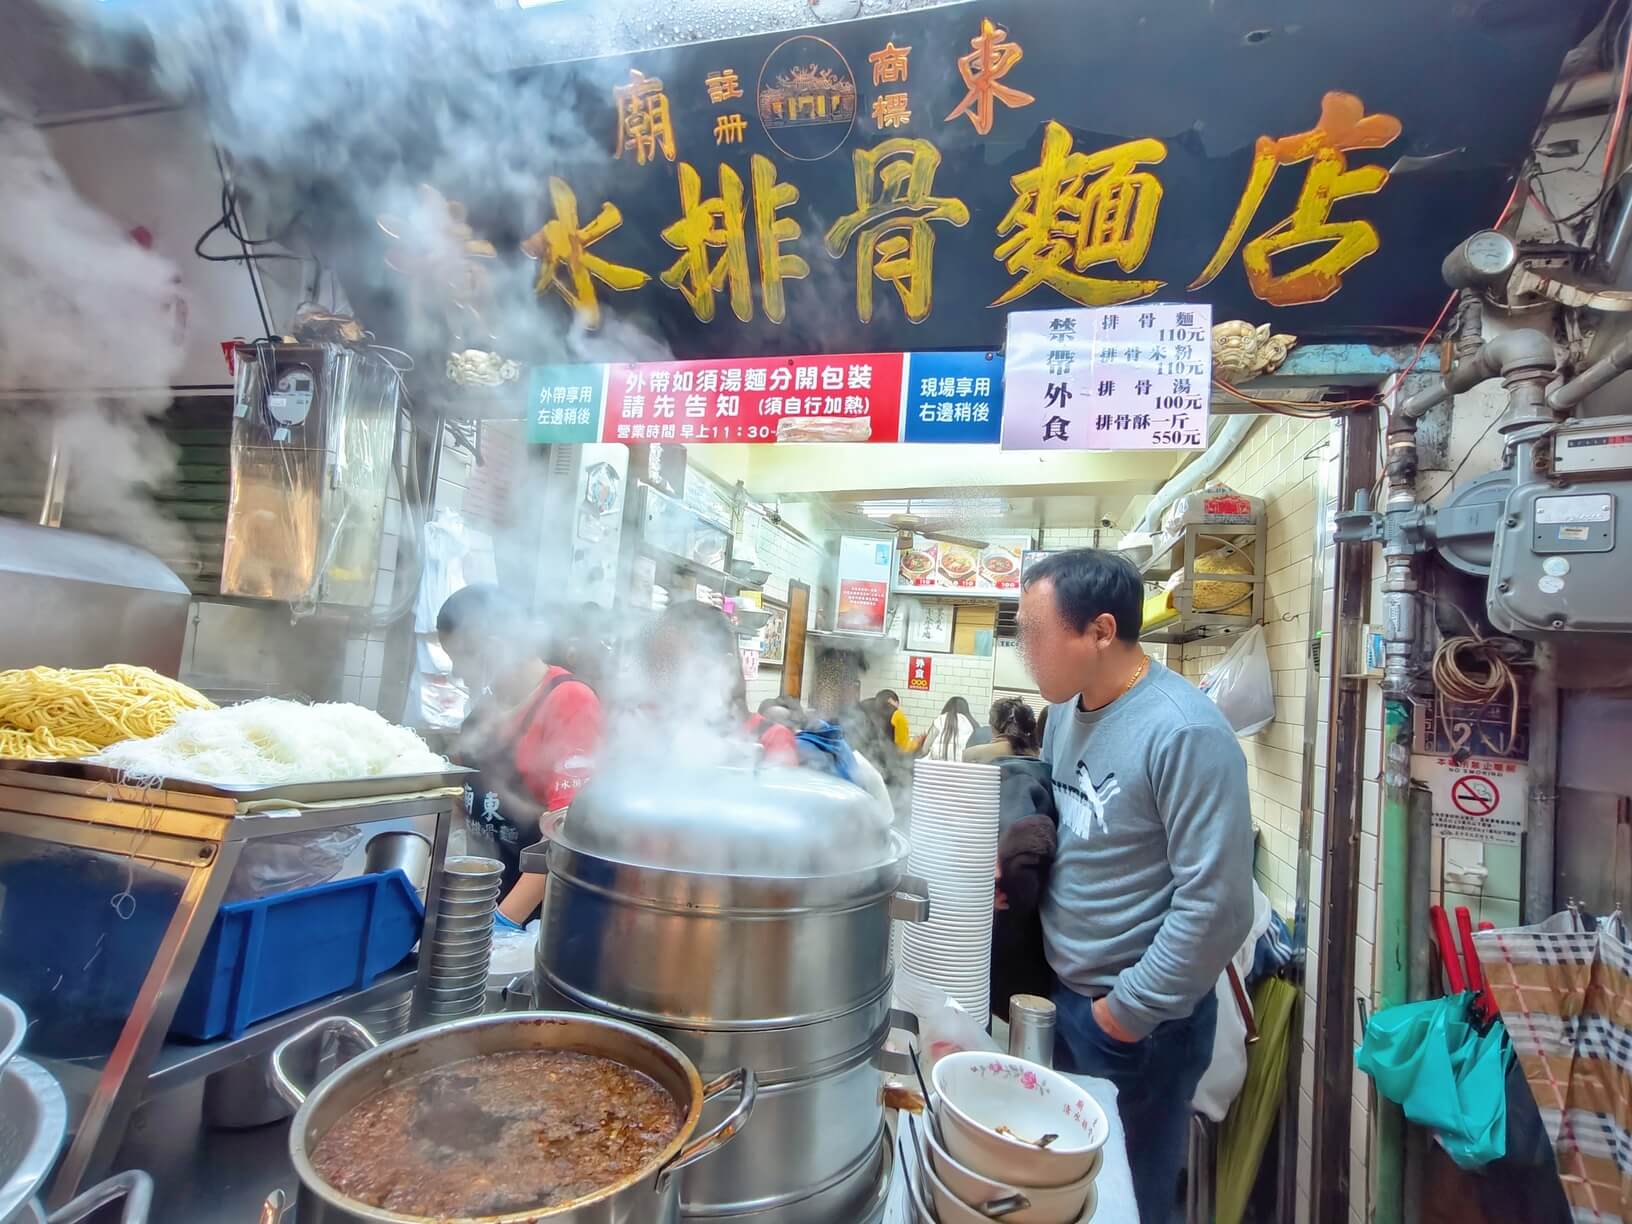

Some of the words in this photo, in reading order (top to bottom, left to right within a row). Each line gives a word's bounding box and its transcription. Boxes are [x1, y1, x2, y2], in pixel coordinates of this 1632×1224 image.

[613, 67, 677, 167] 廟
[943, 16, 1036, 136] 東
[867, 40, 914, 131] 商標
[704, 68, 748, 146] 註冊
[1101, 311, 1195, 330] 排骨麵
[1158, 327, 1205, 342] 110元
[1099, 344, 1193, 363] 排骨米粉
[1157, 360, 1204, 376] 110元
[624, 363, 873, 394] 外帶如須湯麵分開包裝
[920, 377, 991, 399] 現場享用
[1042, 317, 1077, 442] 禁帶外食
[1098, 378, 1192, 397] 排骨湯
[539, 386, 593, 406] 外帶享用
[1154, 394, 1203, 410] 100元
[536, 407, 591, 426] 左邊稍後
[620, 395, 741, 420] 請先告知
[918, 402, 990, 424] 右邊稍後
[616, 423, 677, 440] 營業時間
[1095, 413, 1190, 431] 排骨酥一斤
[1151, 429, 1201, 445] 550元
